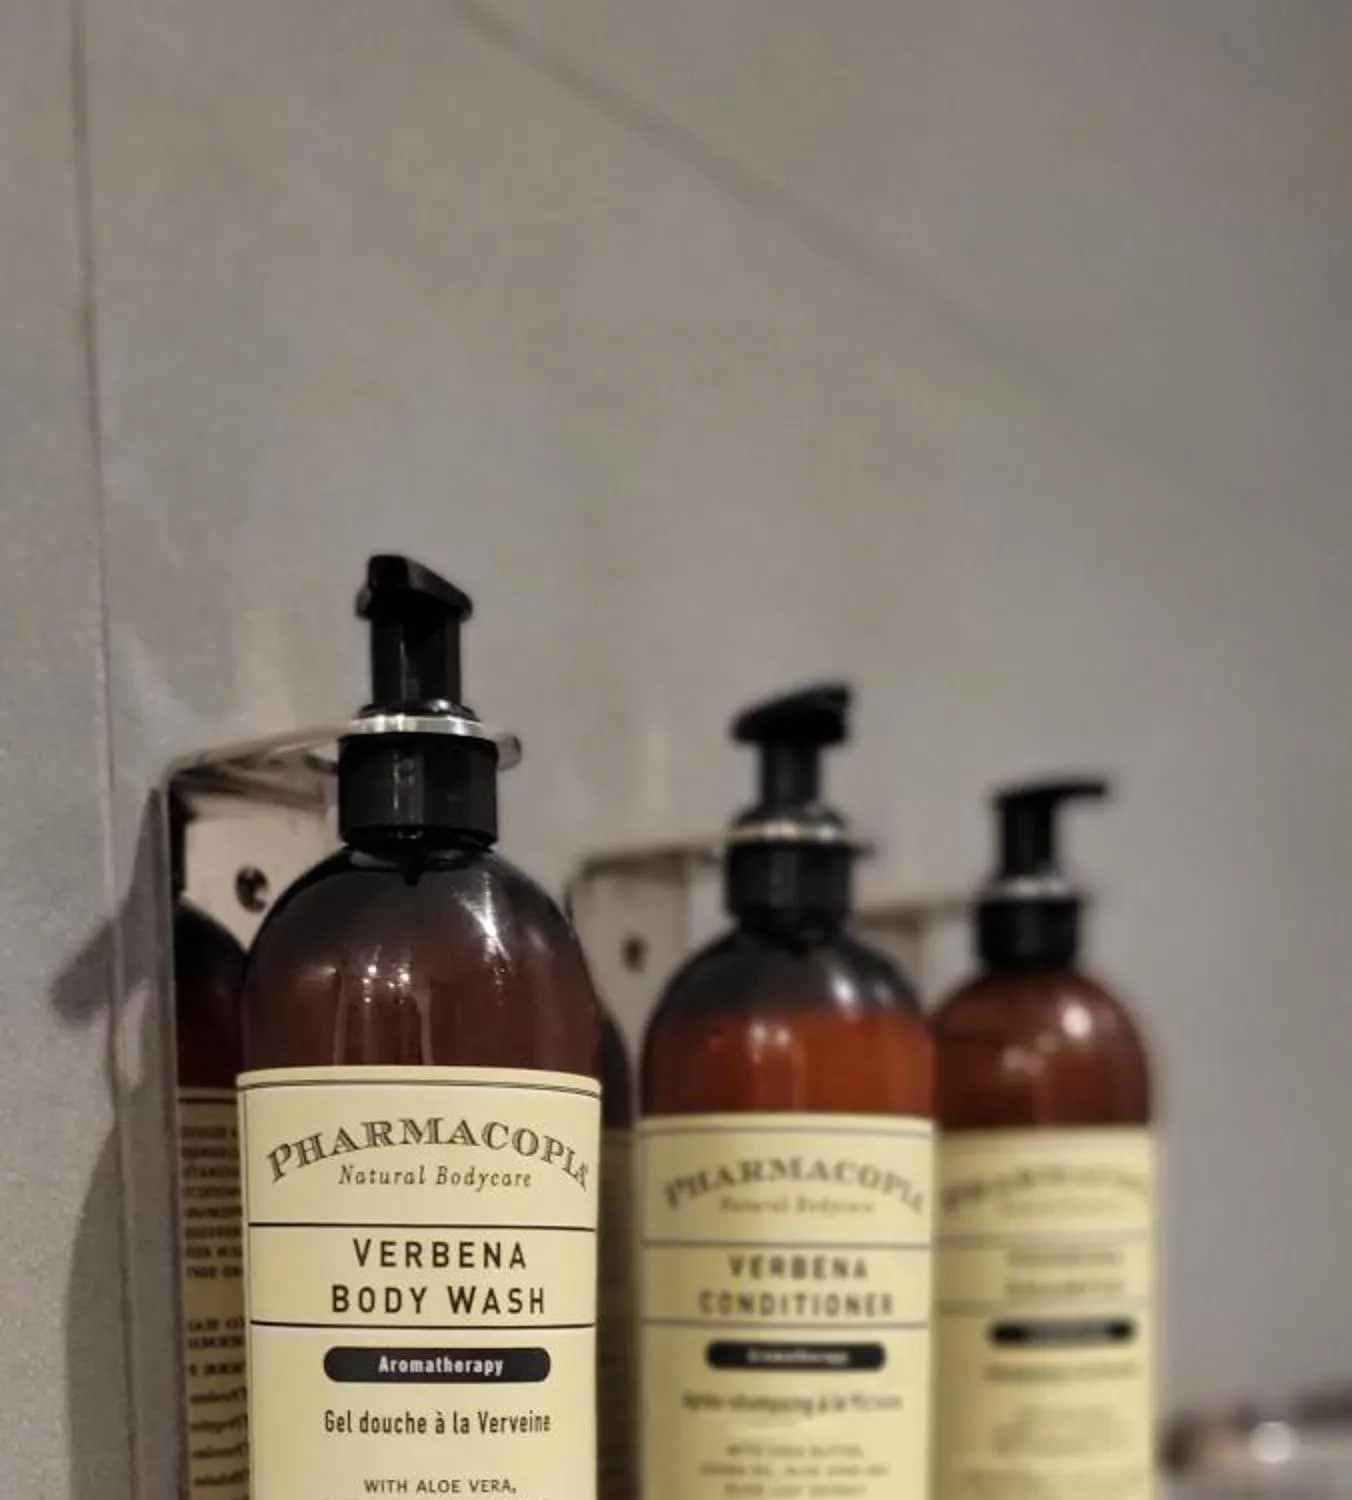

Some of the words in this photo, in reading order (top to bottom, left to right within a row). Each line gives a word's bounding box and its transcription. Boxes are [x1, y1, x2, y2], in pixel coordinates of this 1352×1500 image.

[266, 1117, 591, 1191] PHARMACOPIA
[338, 1165, 425, 1186] Natural
[435, 1165, 532, 1192] Bodycare
[352, 1238, 527, 1270] VERBENA
[728, 1255, 869, 1281] VERBENA
[331, 1284, 428, 1315] BODY
[447, 1285, 545, 1315] WASH
[698, 1290, 894, 1317] CONDITIONER
[378, 1355, 504, 1376] Aromatherapy
[324, 1409, 352, 1433] Gel
[359, 1410, 427, 1434] douche
[435, 1411, 445, 1434] à
[453, 1410, 470, 1434] la
[477, 1409, 551, 1433] Verveine
[363, 1479, 408, 1493] WITH
[416, 1479, 461, 1493] ALOE
[468, 1479, 517, 1495] VERA,
